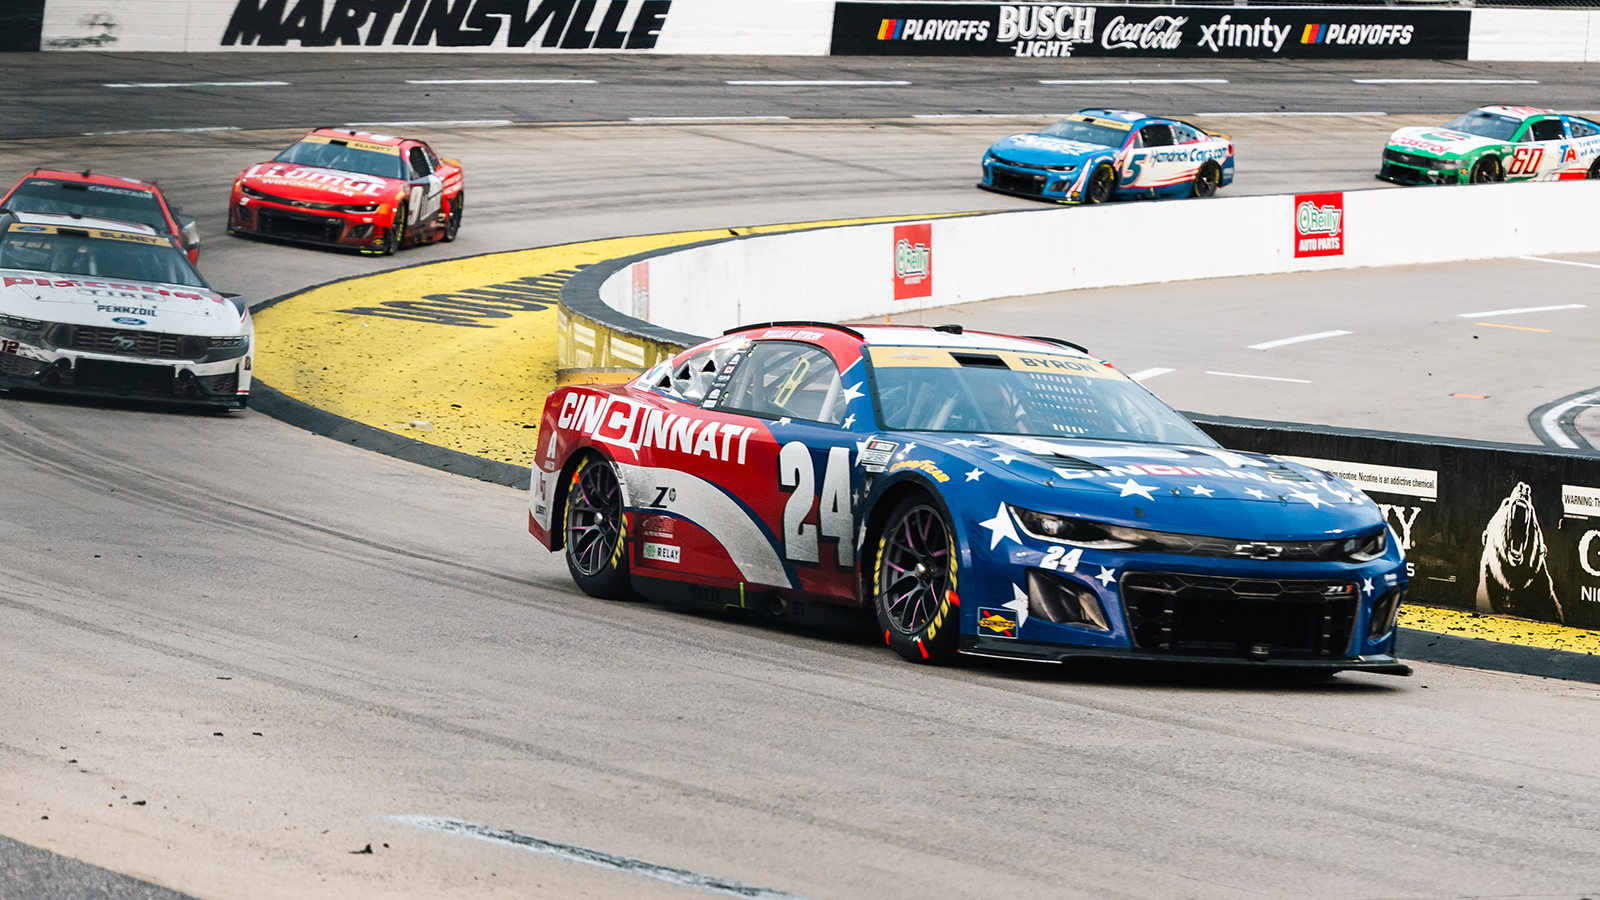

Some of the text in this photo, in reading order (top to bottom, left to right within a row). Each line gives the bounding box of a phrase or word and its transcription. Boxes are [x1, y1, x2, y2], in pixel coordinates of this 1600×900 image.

[221, 0, 672, 49] MARTINSVILLE
[901, 19, 991, 41] PLAYOFFS
[996, 6, 1096, 43] BUSCH
[1197, 15, 1292, 52] xfinity
[1325, 24, 1415, 45] PLAYOFFS
[1013, 41, 1073, 57] LIGHT
[354, 142, 391, 151] ELLIOTT
[1119, 153, 1148, 187] 5
[1508, 148, 1544, 175] 60
[88, 185, 153, 199] CHASTAIN
[261, 178, 355, 197] WINDOW FILM
[1297, 201, 1341, 236] O'Reilly
[99, 232, 158, 244] BLANEY
[1299, 237, 1340, 252] AUTO PARTS
[97, 304, 157, 317] PENNZOIL
[2, 340, 20, 355] 12
[1019, 356, 1098, 373] BYRON
[558, 392, 756, 466] CINCINNATI
[1358, 472, 1378, 483] Nicotine
[1383, 476, 1390, 485] an
[1390, 474, 1412, 487] addictive
[779, 441, 855, 567] 24
[1564, 493, 1593, 507] WARNING:
[657, 547, 679, 560] RELAY
[1039, 546, 1083, 573] 24
